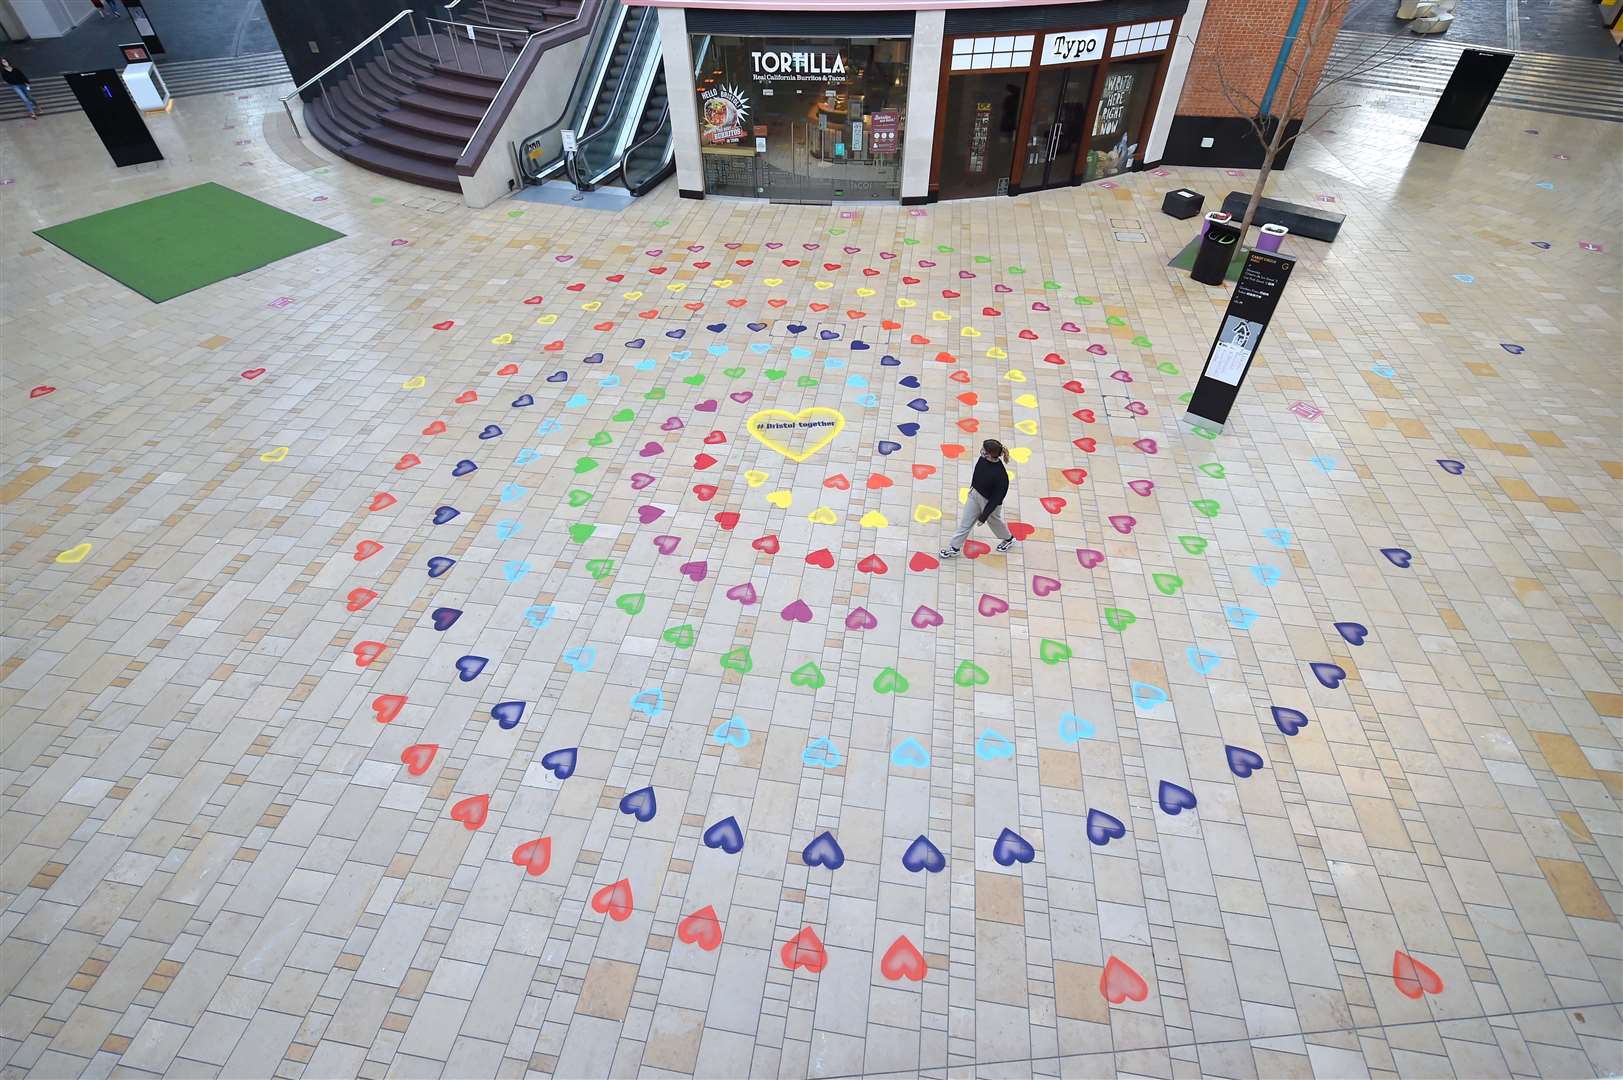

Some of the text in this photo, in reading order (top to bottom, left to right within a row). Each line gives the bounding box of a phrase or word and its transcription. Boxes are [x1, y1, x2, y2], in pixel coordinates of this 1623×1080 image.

[1054, 36, 1096, 59] Typo
[752, 51, 845, 73] TORTILLA
[701, 88, 718, 99] HELLO
[1107, 91, 1124, 106] HERE
[1102, 106, 1123, 120] RIGHT
[1100, 119, 1119, 135] NOW
